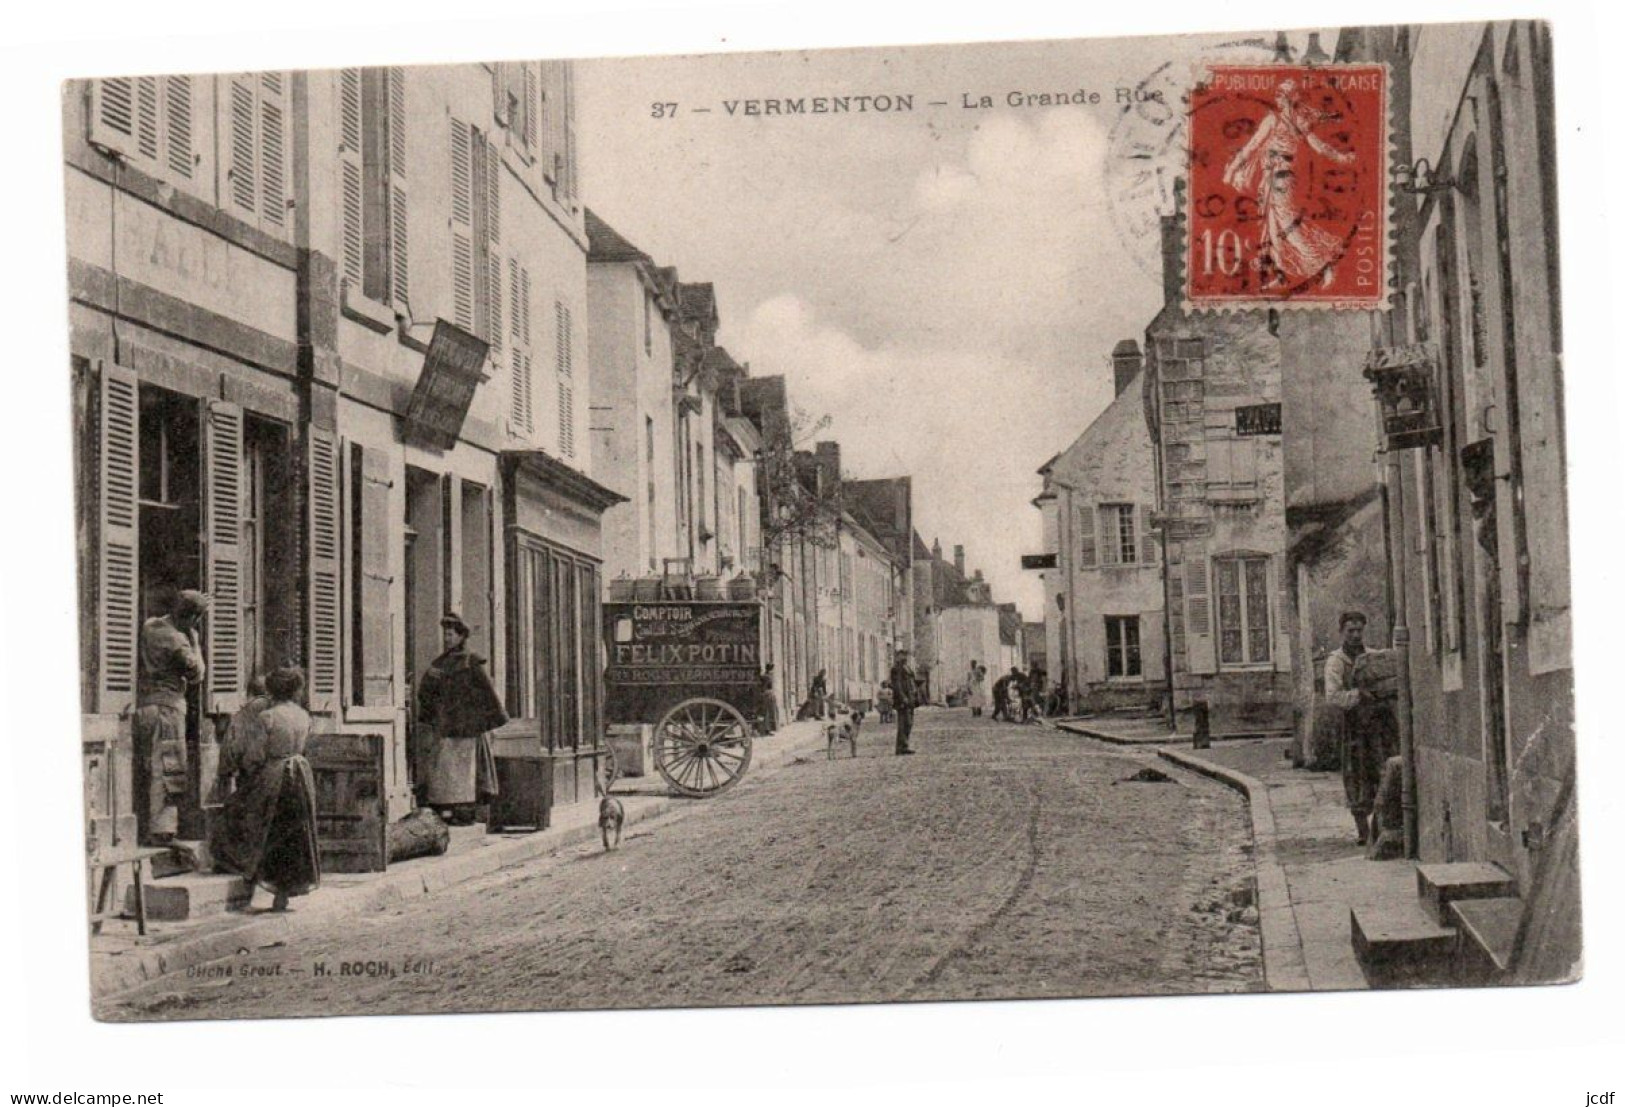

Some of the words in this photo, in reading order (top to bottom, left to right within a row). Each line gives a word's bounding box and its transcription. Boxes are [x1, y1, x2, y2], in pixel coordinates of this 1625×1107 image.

[651, 102, 678, 118] 37
[722, 94, 915, 117] VERMENTON
[962, 93, 994, 109] La
[1006, 89, 1101, 108] Grande
[1115, 87, 1164, 104] Rue
[615, 644, 684, 665] FELIX
[688, 644, 756, 663] POTIN
[313, 962, 332, 977] H.
